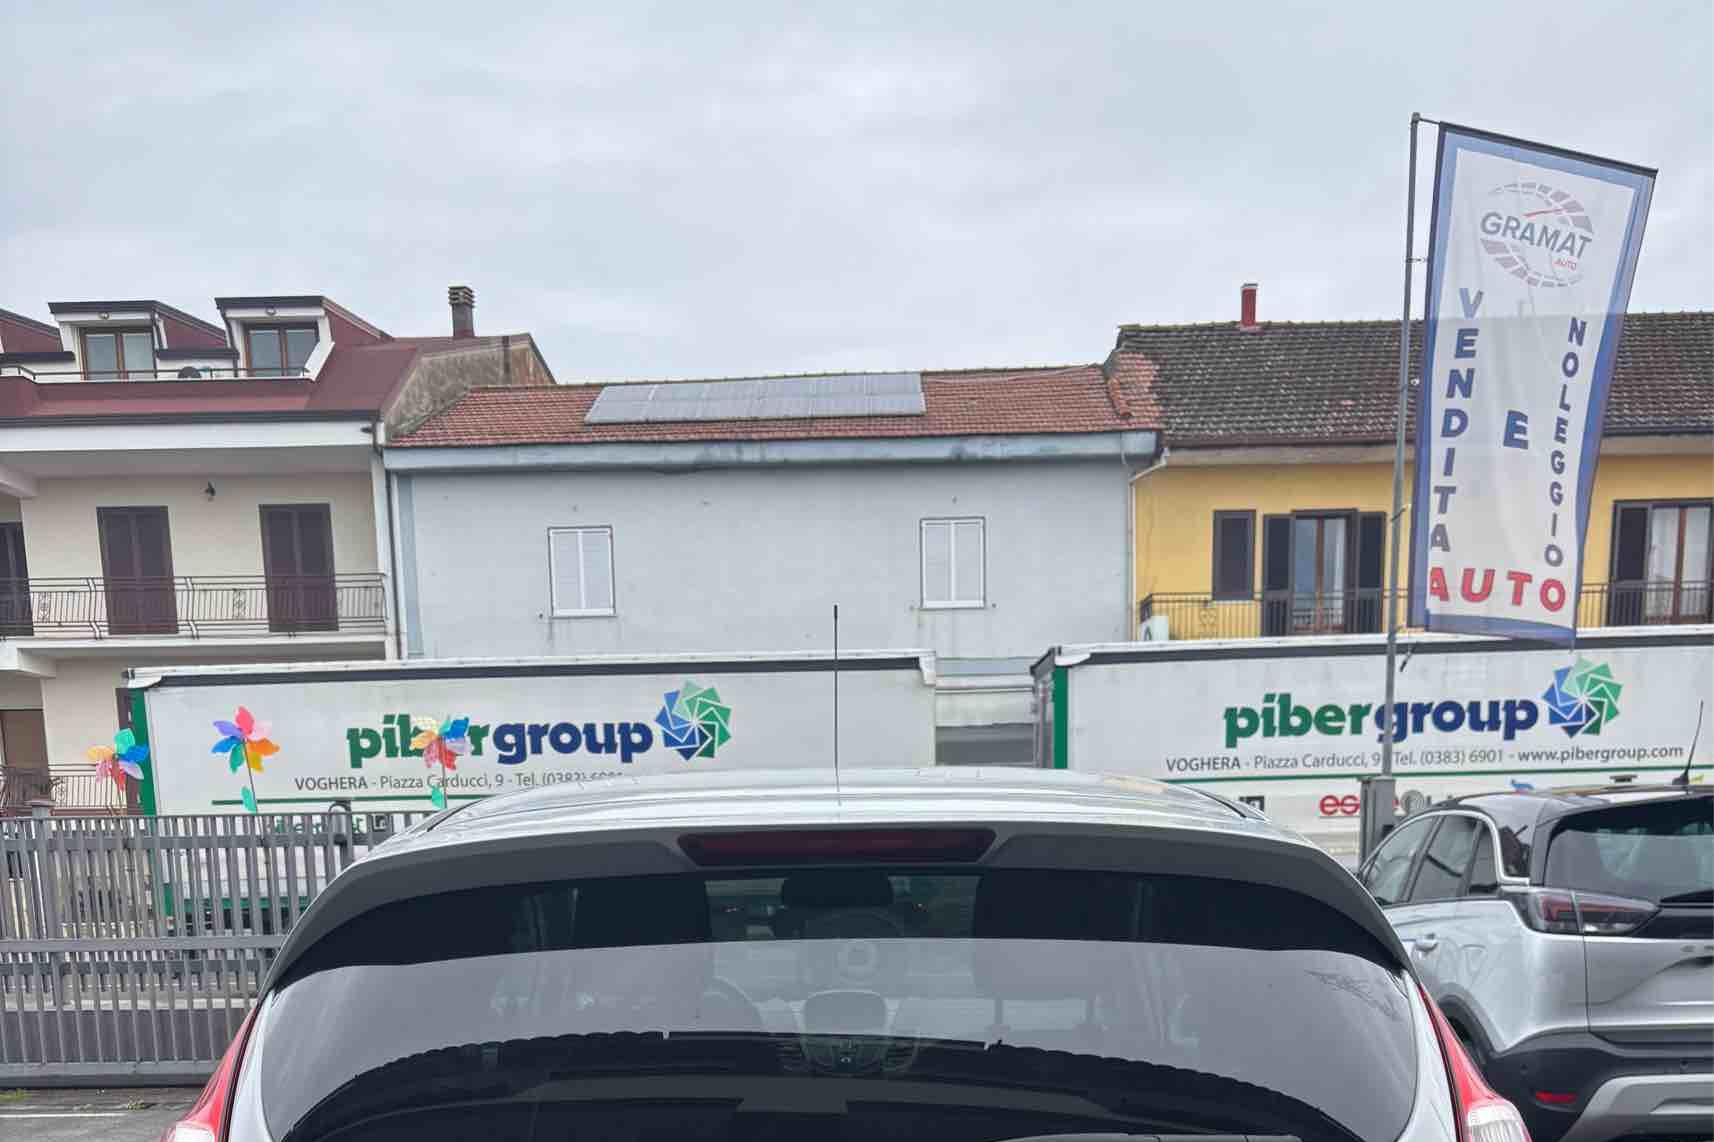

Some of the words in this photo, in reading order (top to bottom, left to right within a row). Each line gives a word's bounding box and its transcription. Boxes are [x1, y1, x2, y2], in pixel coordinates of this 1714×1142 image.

[1480, 211, 1593, 260] GRAMAT
[1430, 287, 1484, 552] VENDITA
[1502, 410, 1529, 450] E
[1544, 316, 1588, 567] NOLEGGIO
[1429, 566, 1566, 613] AUTO
[346, 712, 654, 769] pibrgroup
[1166, 755, 1241, 772] VOGHERA
[1254, 754, 1299, 769] Piazza
[1302, 752, 1368, 769] Carducci,
[1371, 751, 1381, 767] 9
[1392, 751, 1418, 768] Tel.
[1420, 750, 1466, 767] (0383)
[1469, 749, 1502, 764] 6901
[1517, 744, 1684, 763] www.pibergroup.com
[294, 775, 369, 791] VOGHERA
[380, 775, 424, 789] Piazza
[495, 774, 504, 787] 9
[516, 773, 539, 787] Tel.
